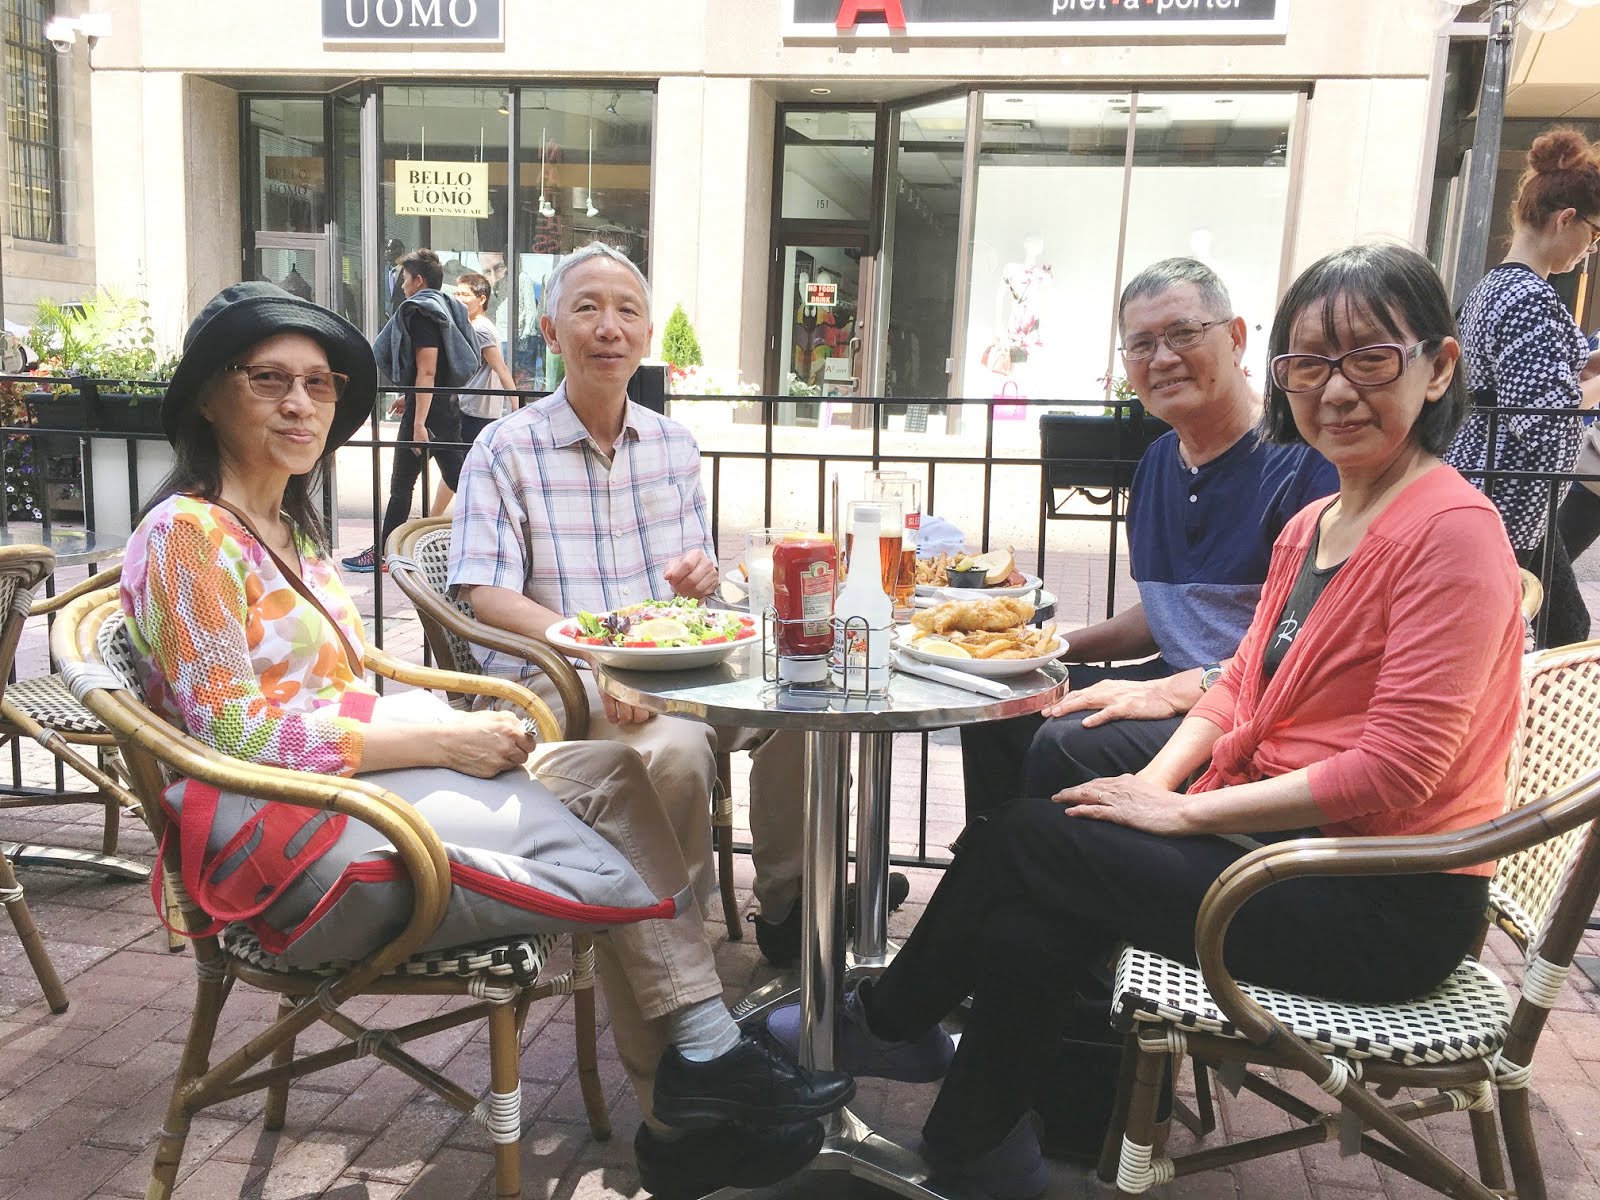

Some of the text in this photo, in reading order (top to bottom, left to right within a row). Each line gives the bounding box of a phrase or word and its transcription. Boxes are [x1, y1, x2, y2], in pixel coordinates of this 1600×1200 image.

[346, 0, 478, 28] UOMO
[409, 170, 472, 187] BELLO
[413, 189, 472, 206] UOMO
[816, 199, 829, 209] 151
[424, 206, 452, 214] MEN'S
[808, 285, 835, 293] NO FOOD
[811, 296, 831, 304] DRINK
[1274, 610, 1303, 648] R
